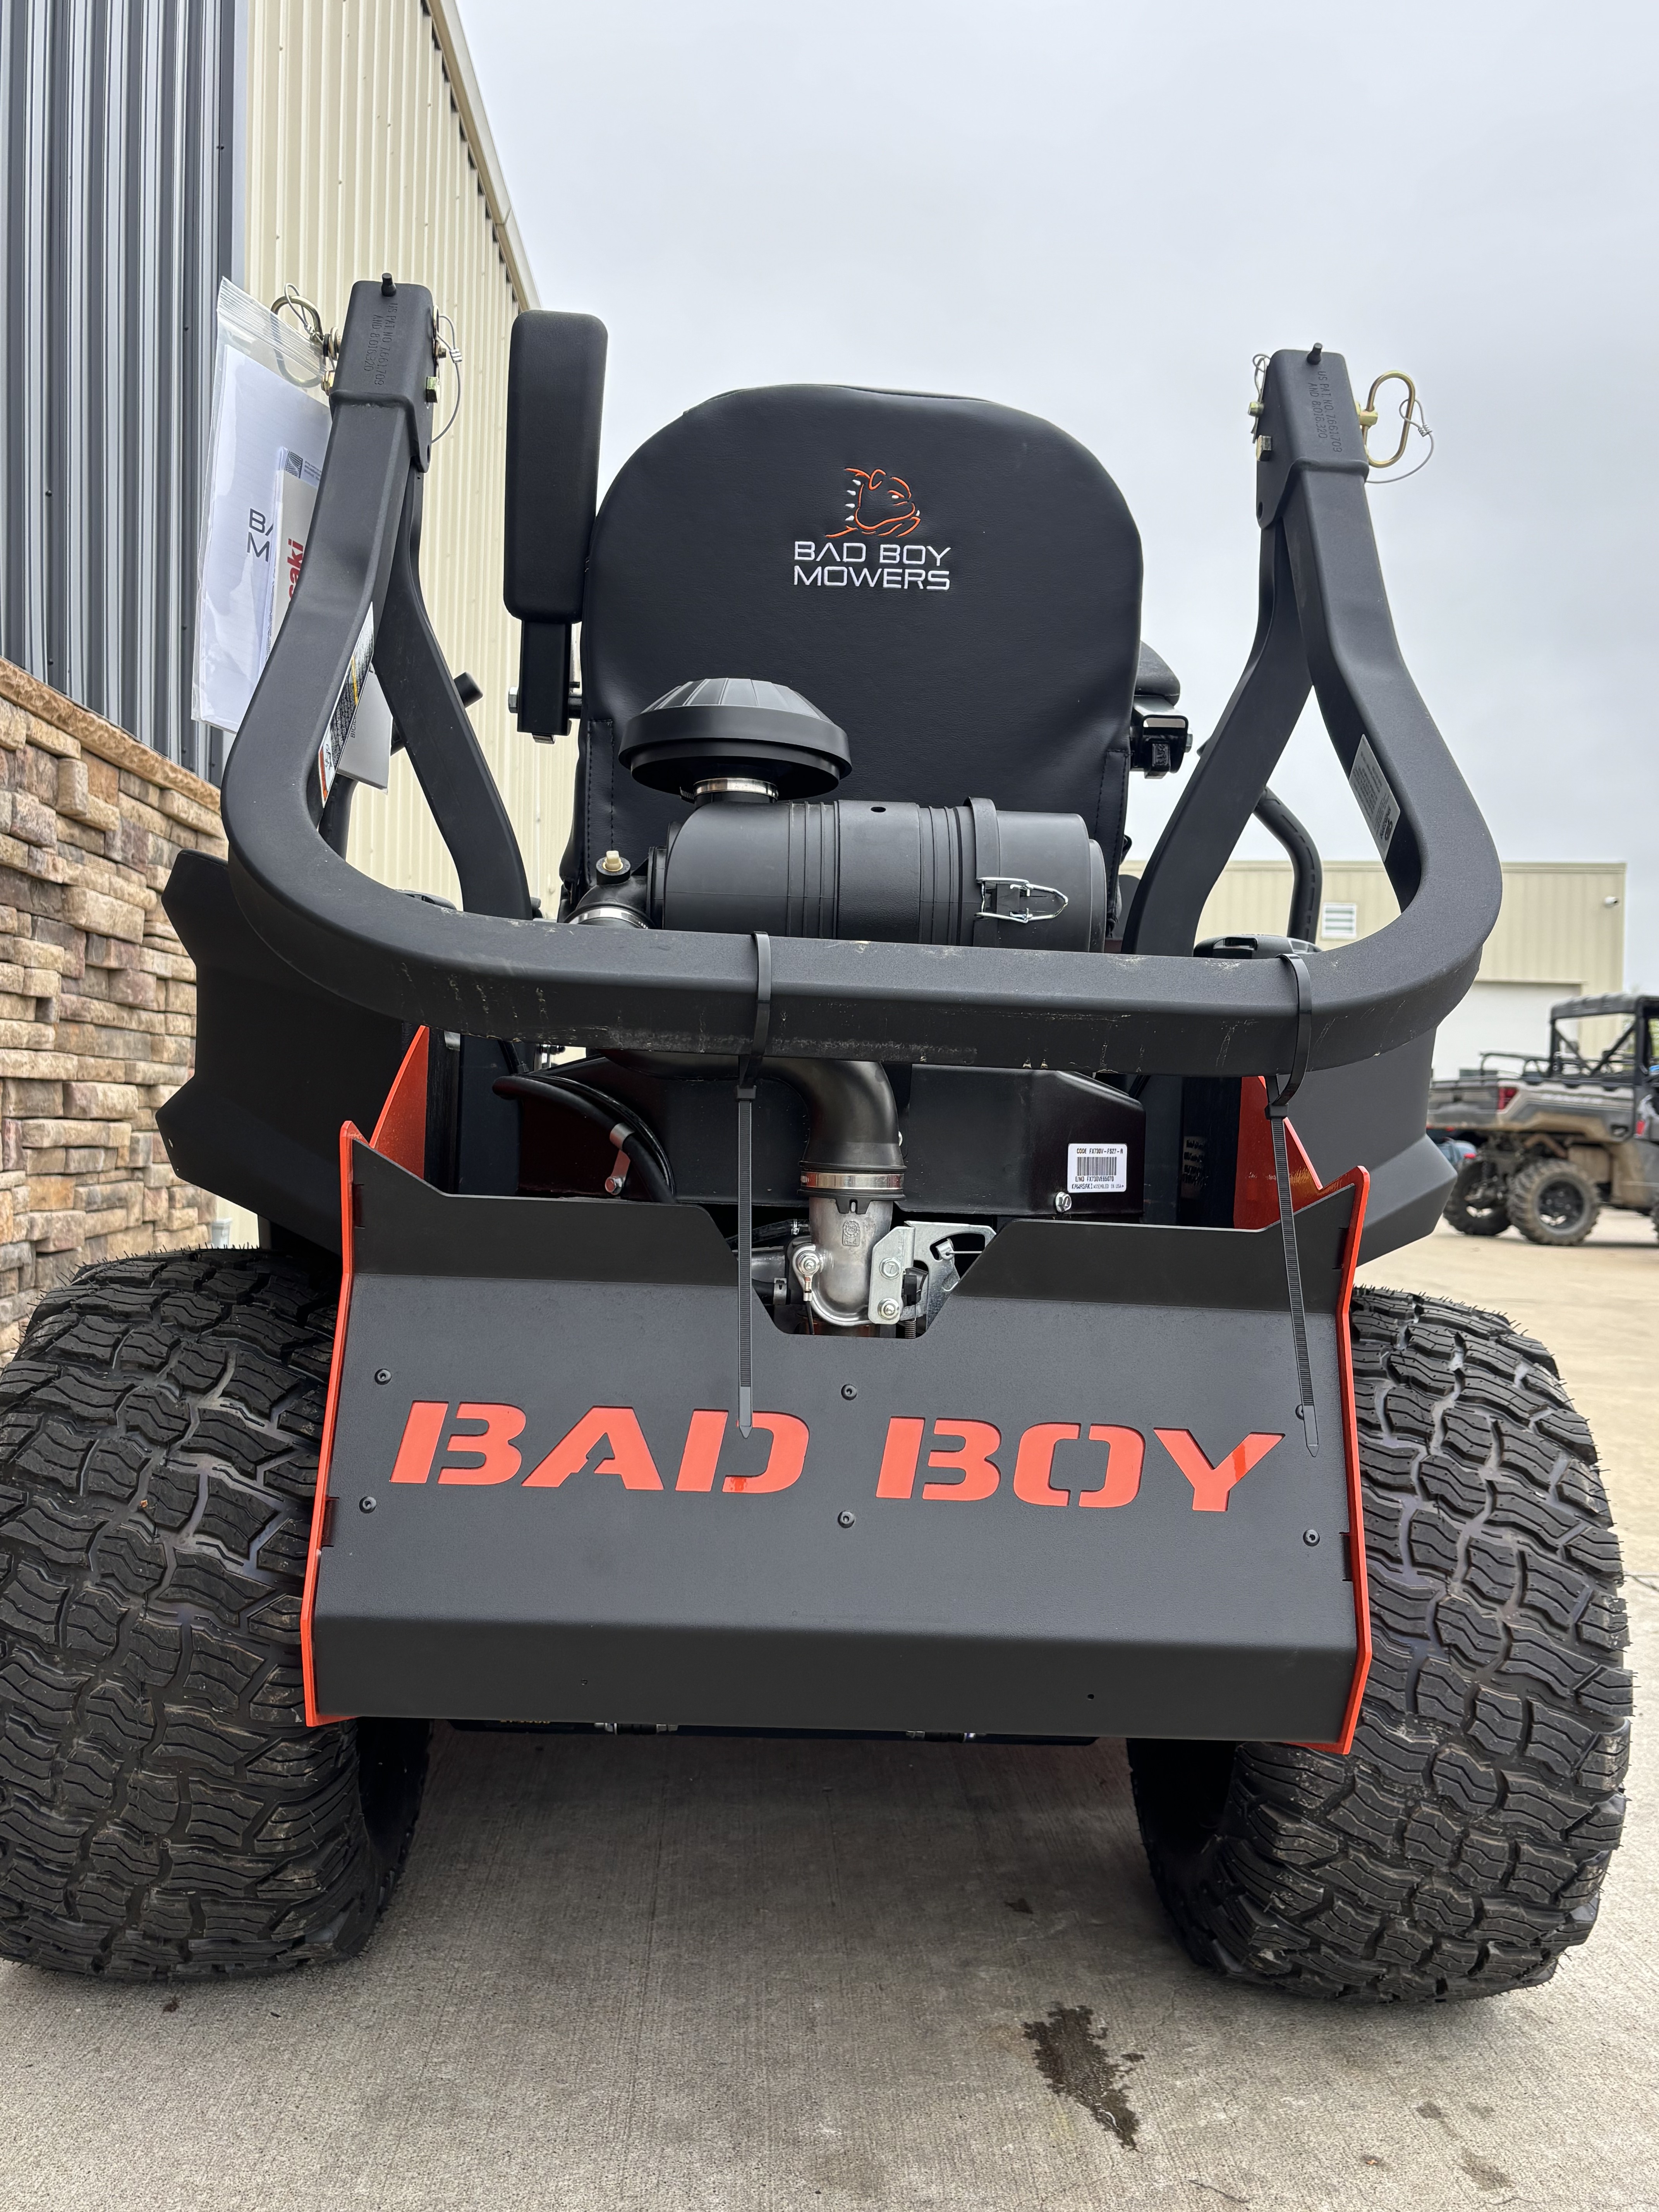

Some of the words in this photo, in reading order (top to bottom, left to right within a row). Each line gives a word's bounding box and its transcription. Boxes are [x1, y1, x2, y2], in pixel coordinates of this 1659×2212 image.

[1317, 371, 1328, 381] US
[1308, 383, 1319, 397] AND
[794, 541, 866, 562] BAD
[879, 544, 951, 566] BOY
[793, 565, 950, 590] MOWERS
[888, 1263, 895, 1274] 7
[390, 1400, 810, 1494] BAD
[876, 1416, 1285, 1513] BOY
